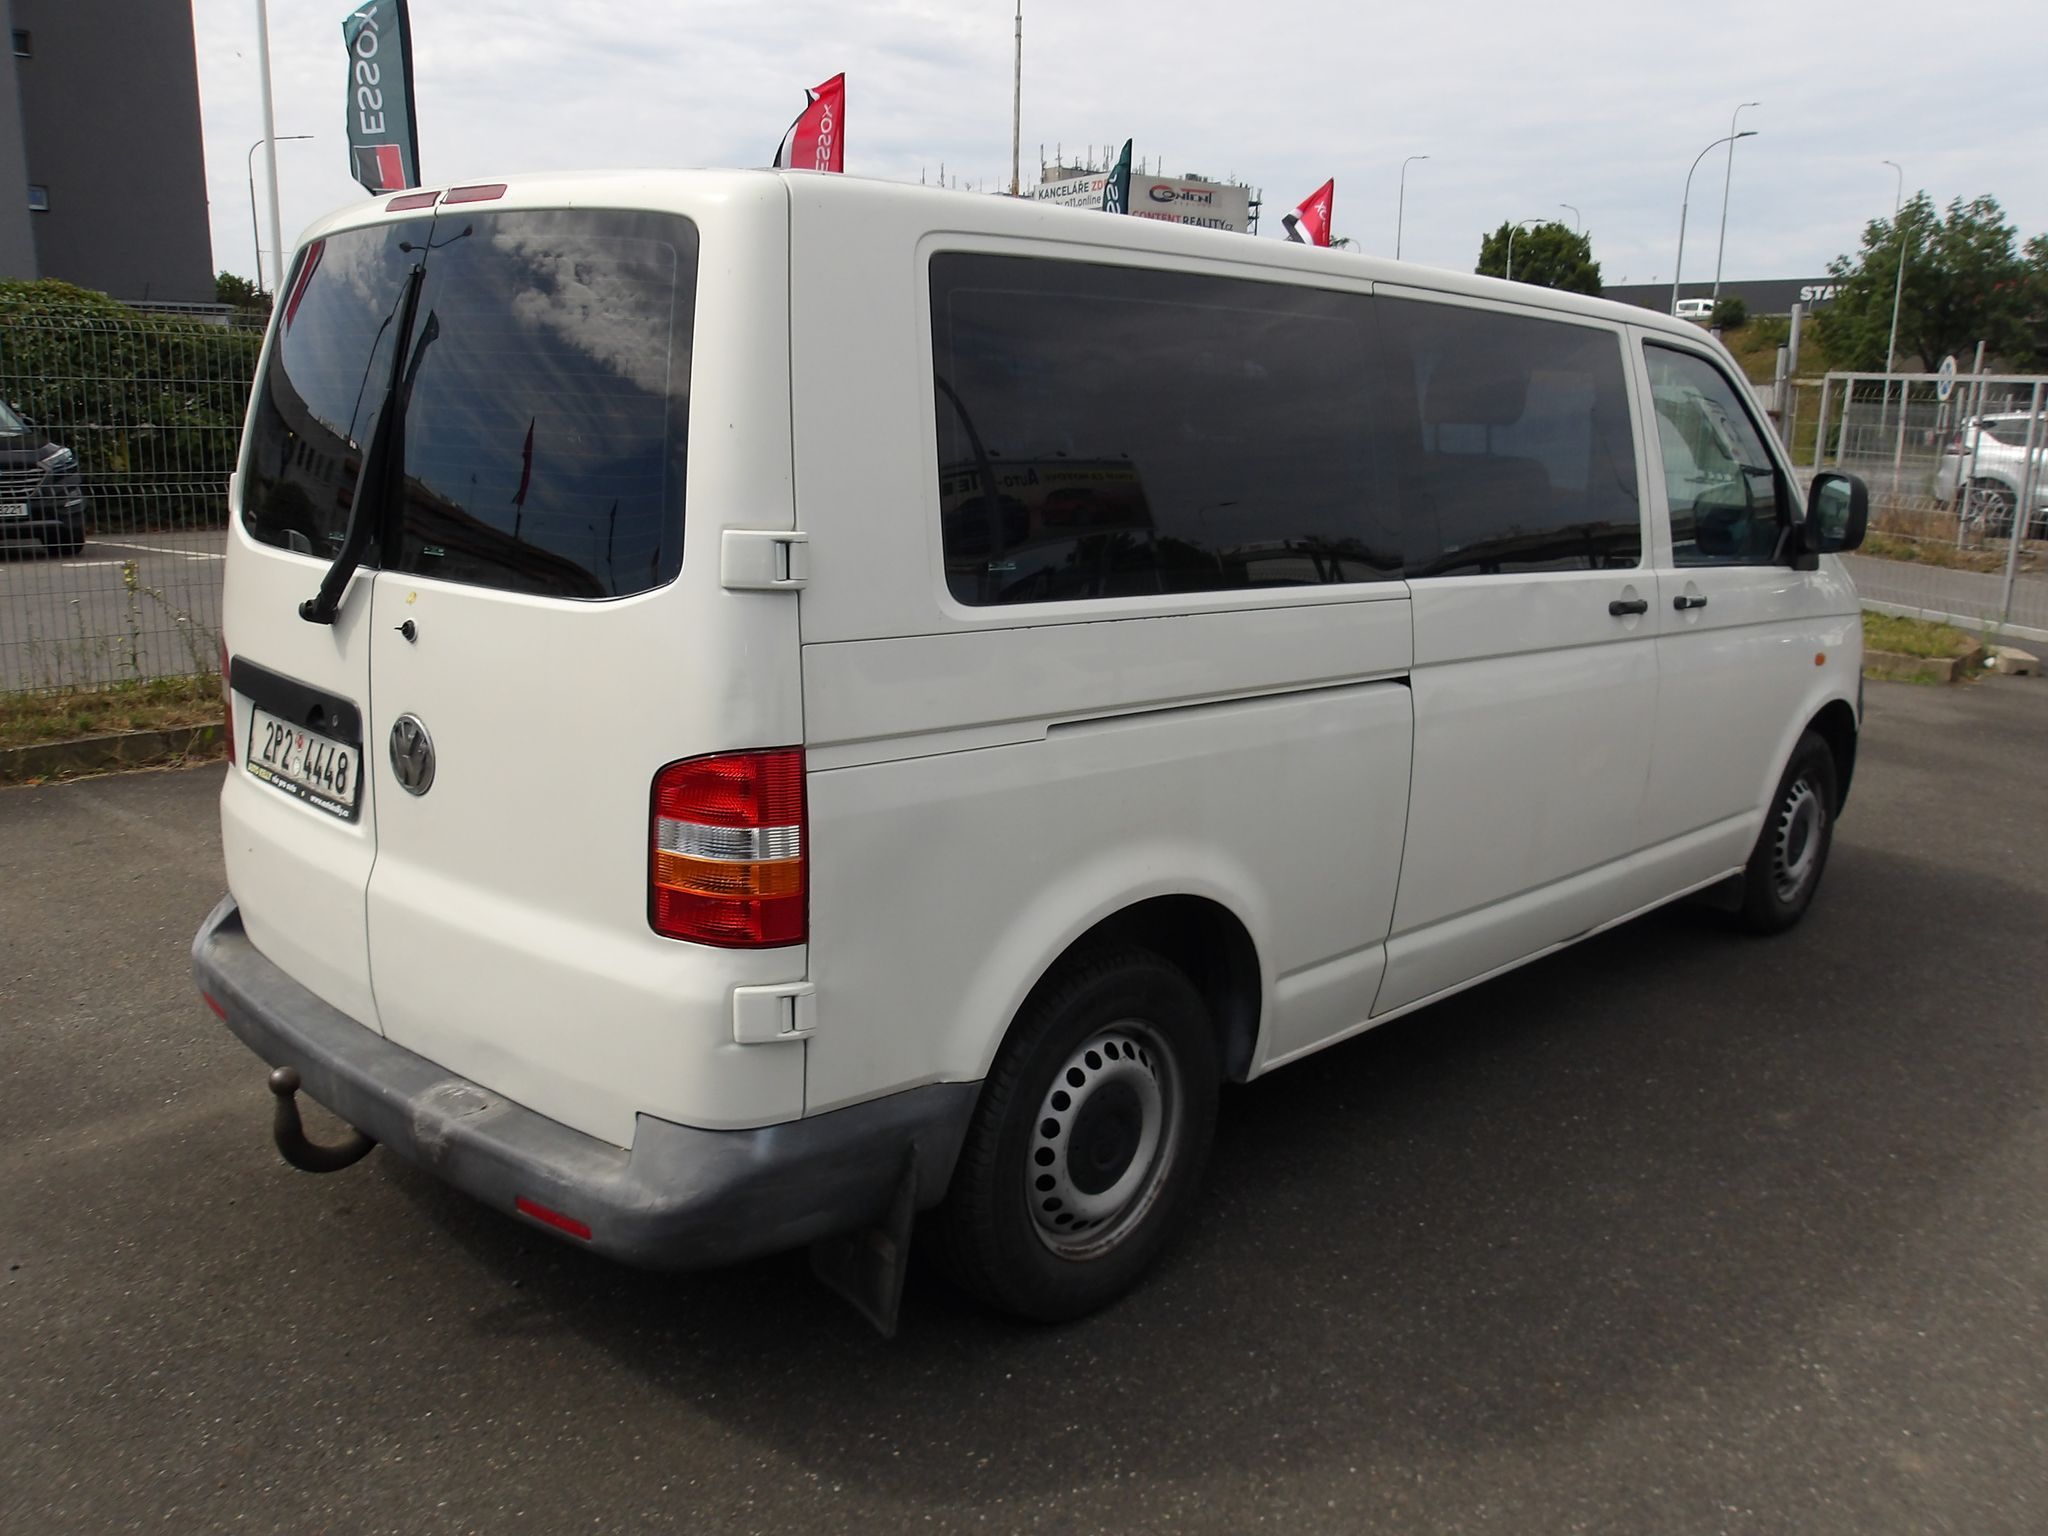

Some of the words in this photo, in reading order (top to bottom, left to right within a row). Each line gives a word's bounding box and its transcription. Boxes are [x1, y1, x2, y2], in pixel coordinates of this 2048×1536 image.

[1038, 182, 1090, 201] KANCELÁŘE
[263, 721, 294, 771] 2P2
[302, 738, 349, 795] 4448
